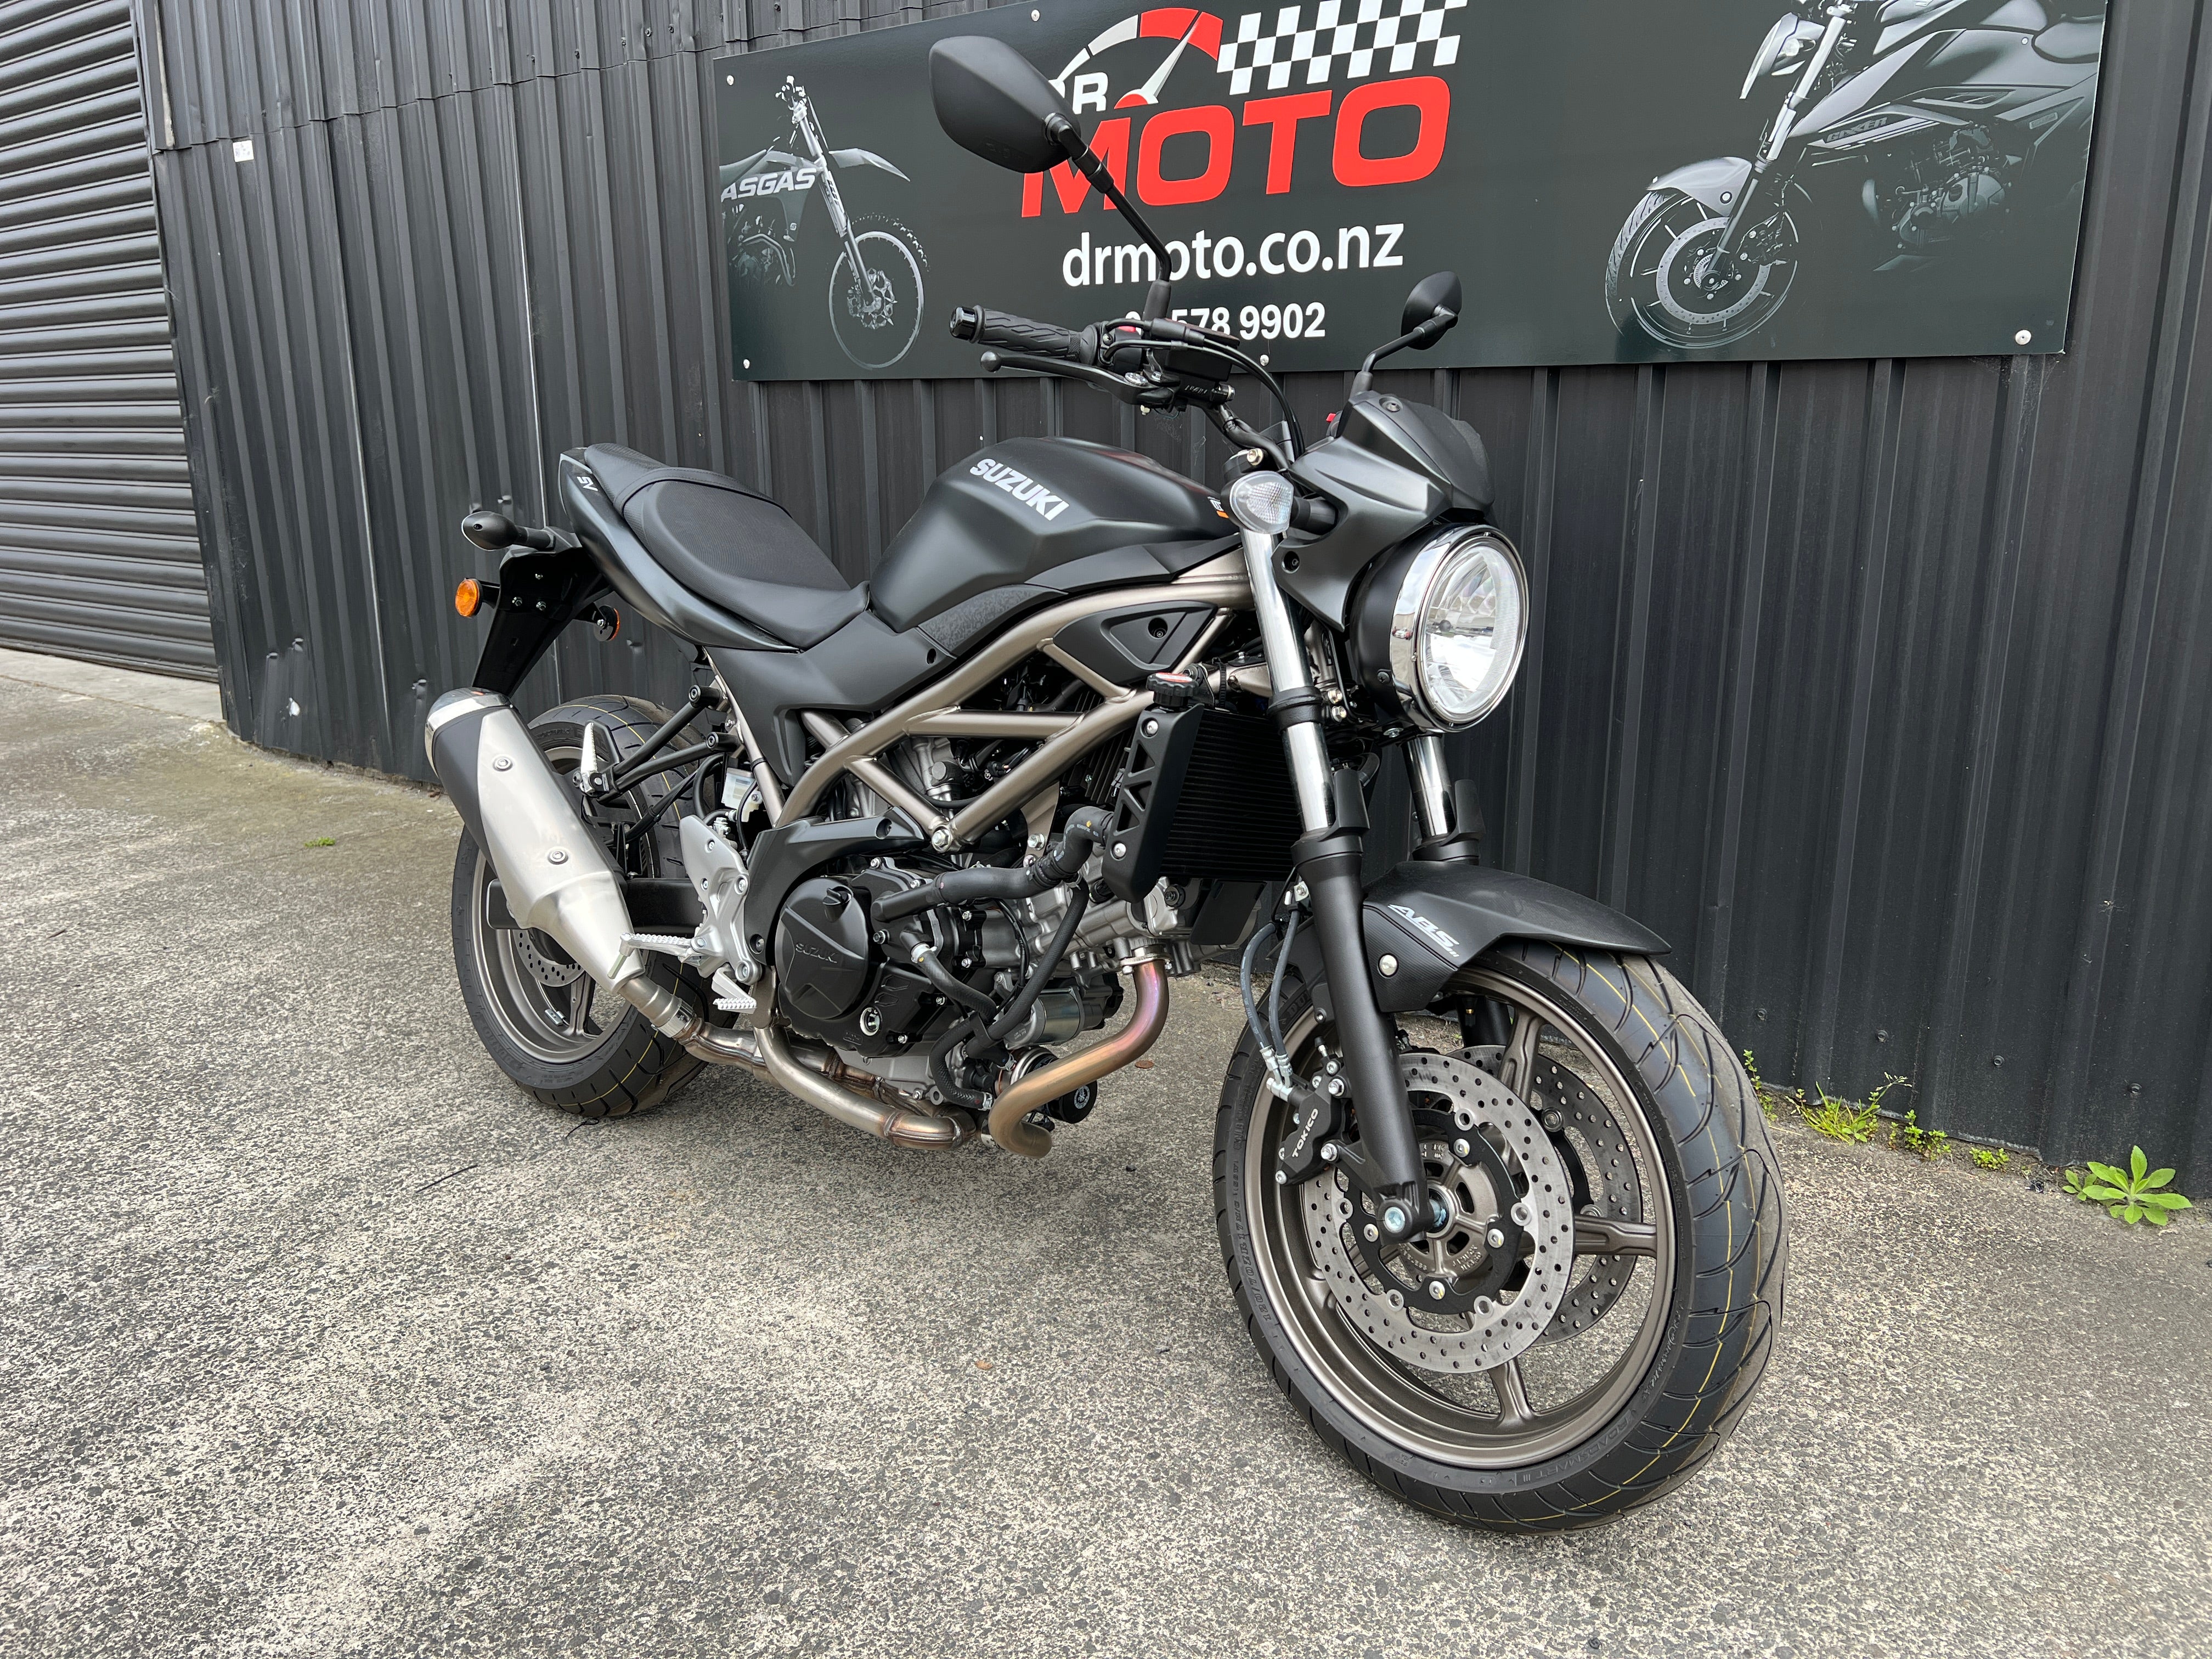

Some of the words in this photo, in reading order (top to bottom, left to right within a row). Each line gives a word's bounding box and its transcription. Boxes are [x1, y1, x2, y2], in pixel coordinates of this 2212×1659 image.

[1048, 72, 1108, 115] R
[1022, 76, 1451, 217] MOTO
[1062, 223, 1404, 287] drmoto.co.nz
[1239, 302, 1325, 340] 9902
[969, 458, 1069, 521] SUZUKI
[1387, 904, 1460, 950] ABS
[1291, 1108, 1319, 1158] TOKICO
